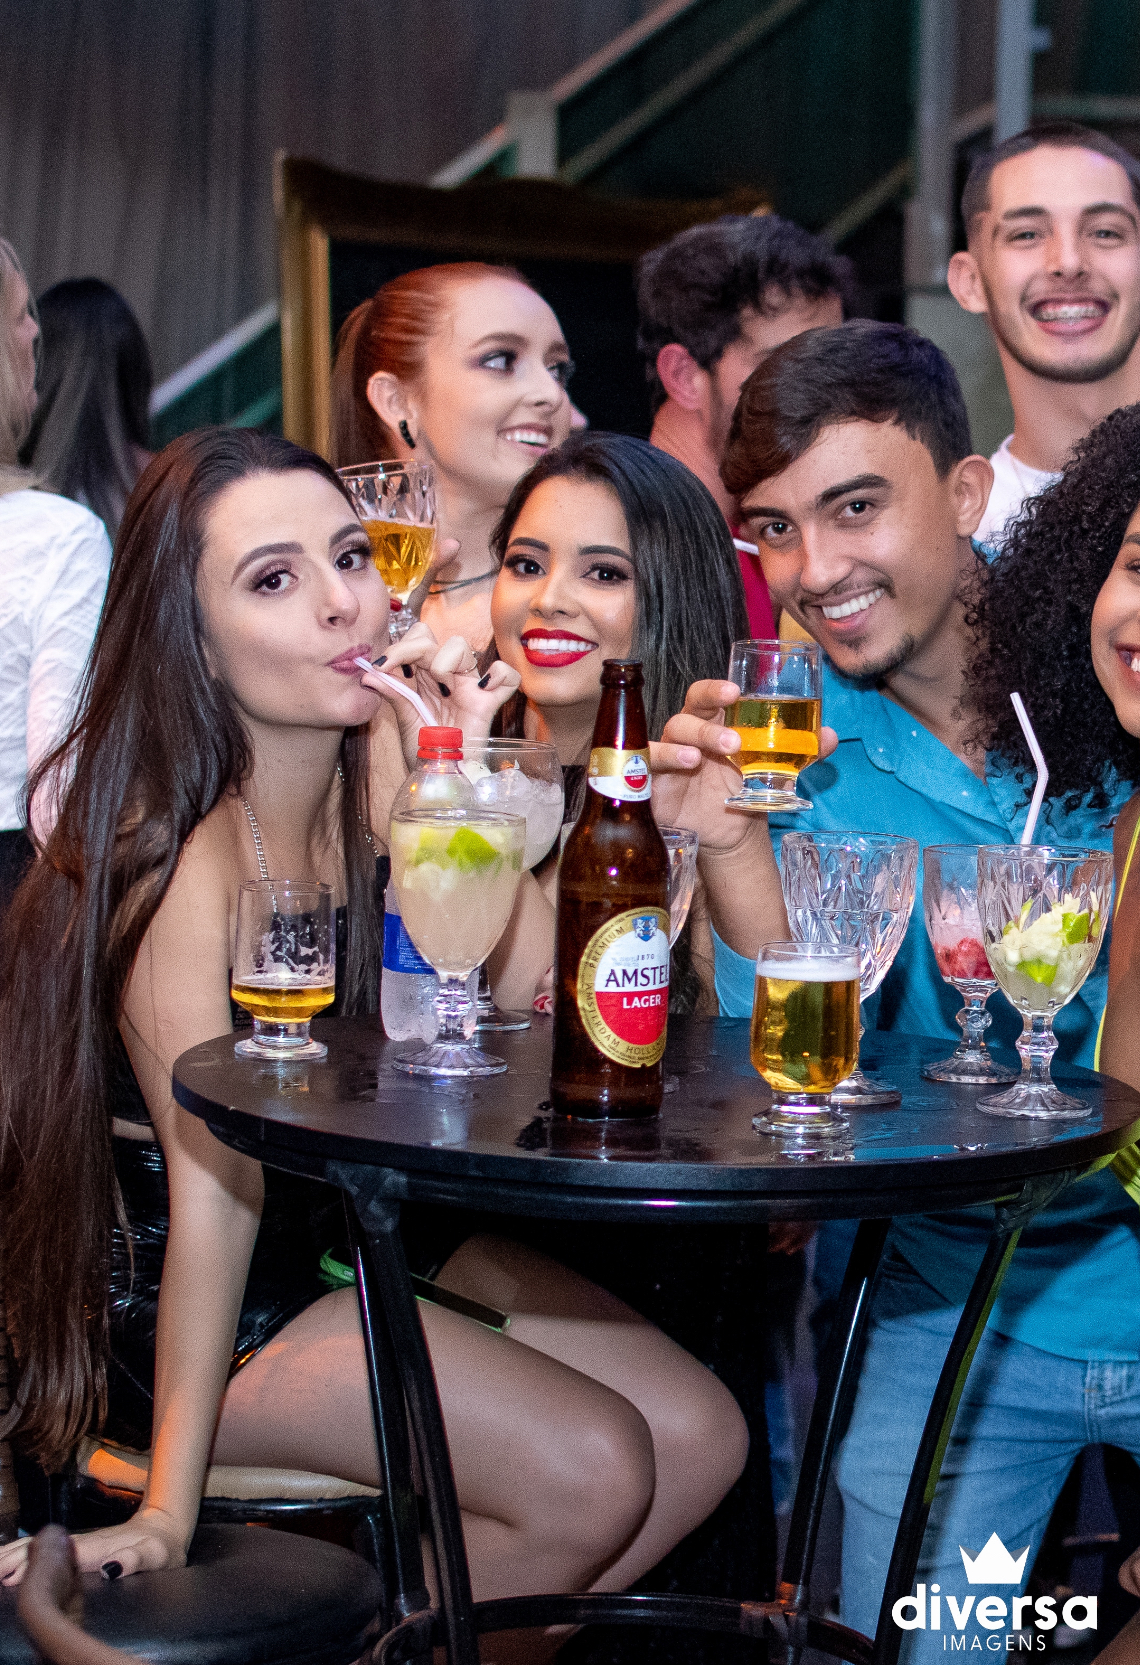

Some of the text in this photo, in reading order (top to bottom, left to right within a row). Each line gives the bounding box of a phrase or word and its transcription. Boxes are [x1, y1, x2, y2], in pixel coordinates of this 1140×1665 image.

[589, 926, 625, 969] PREMIUM
[636, 953, 655, 961] 1870
[586, 982, 621, 1048] AMSTERDAM
[622, 994, 662, 1009] LAGER
